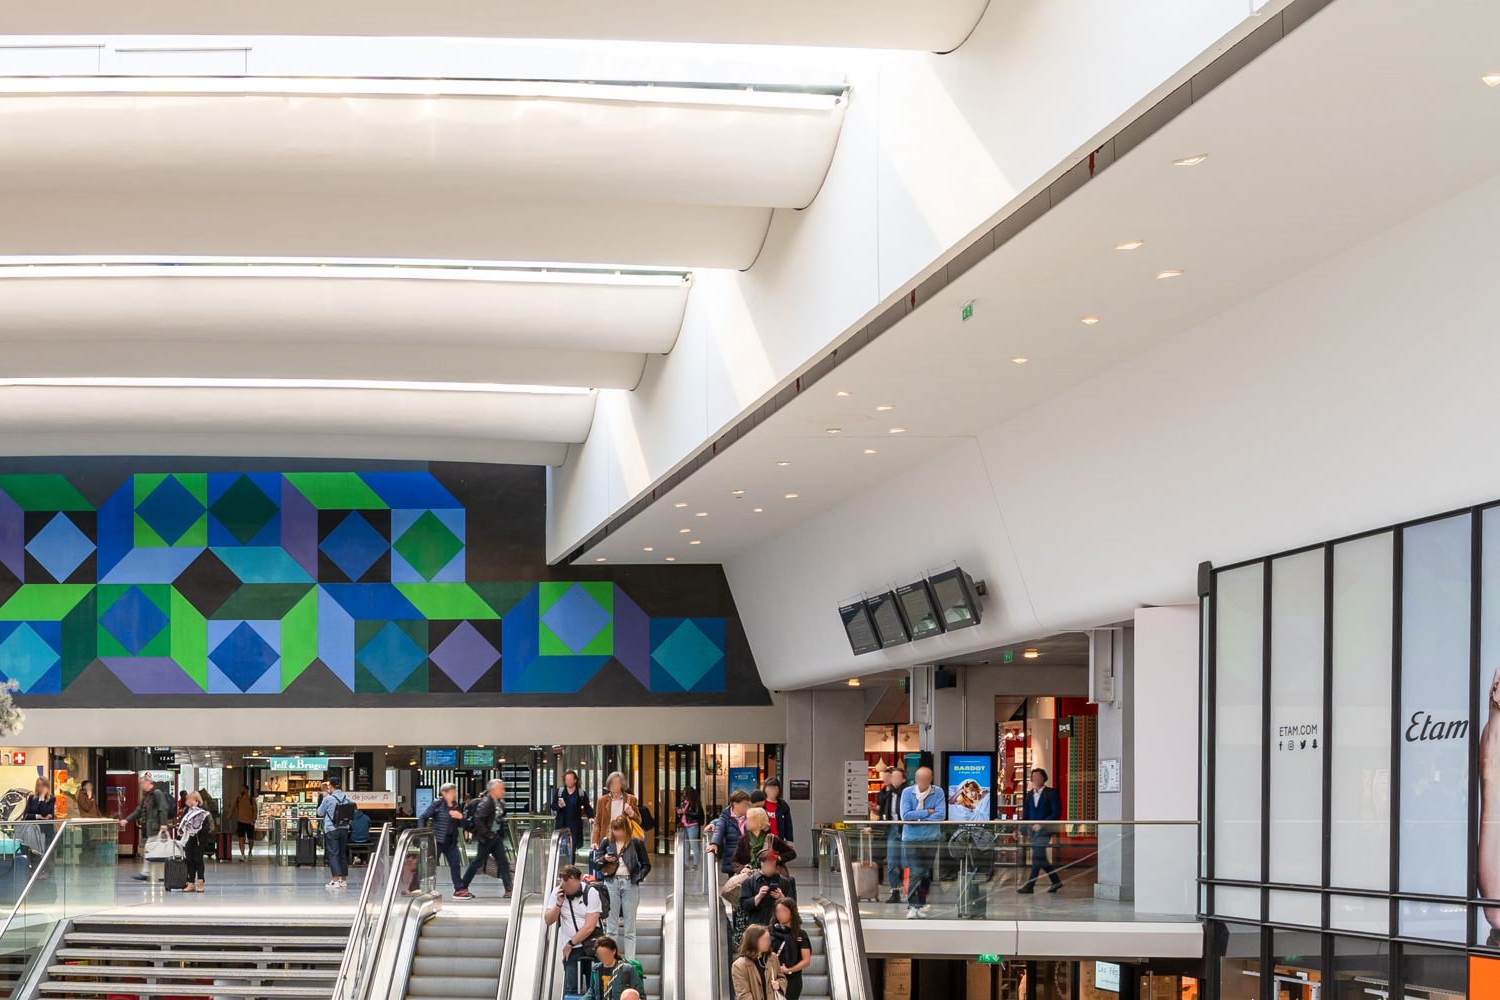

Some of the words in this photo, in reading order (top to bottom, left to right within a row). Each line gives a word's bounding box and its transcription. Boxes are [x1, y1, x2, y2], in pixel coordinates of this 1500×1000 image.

[1279, 724, 1318, 737] ETAM.COM
[1405, 711, 1469, 742] Etam
[274, 760, 289, 769] Jeff
[297, 759, 327, 770] Bruges
